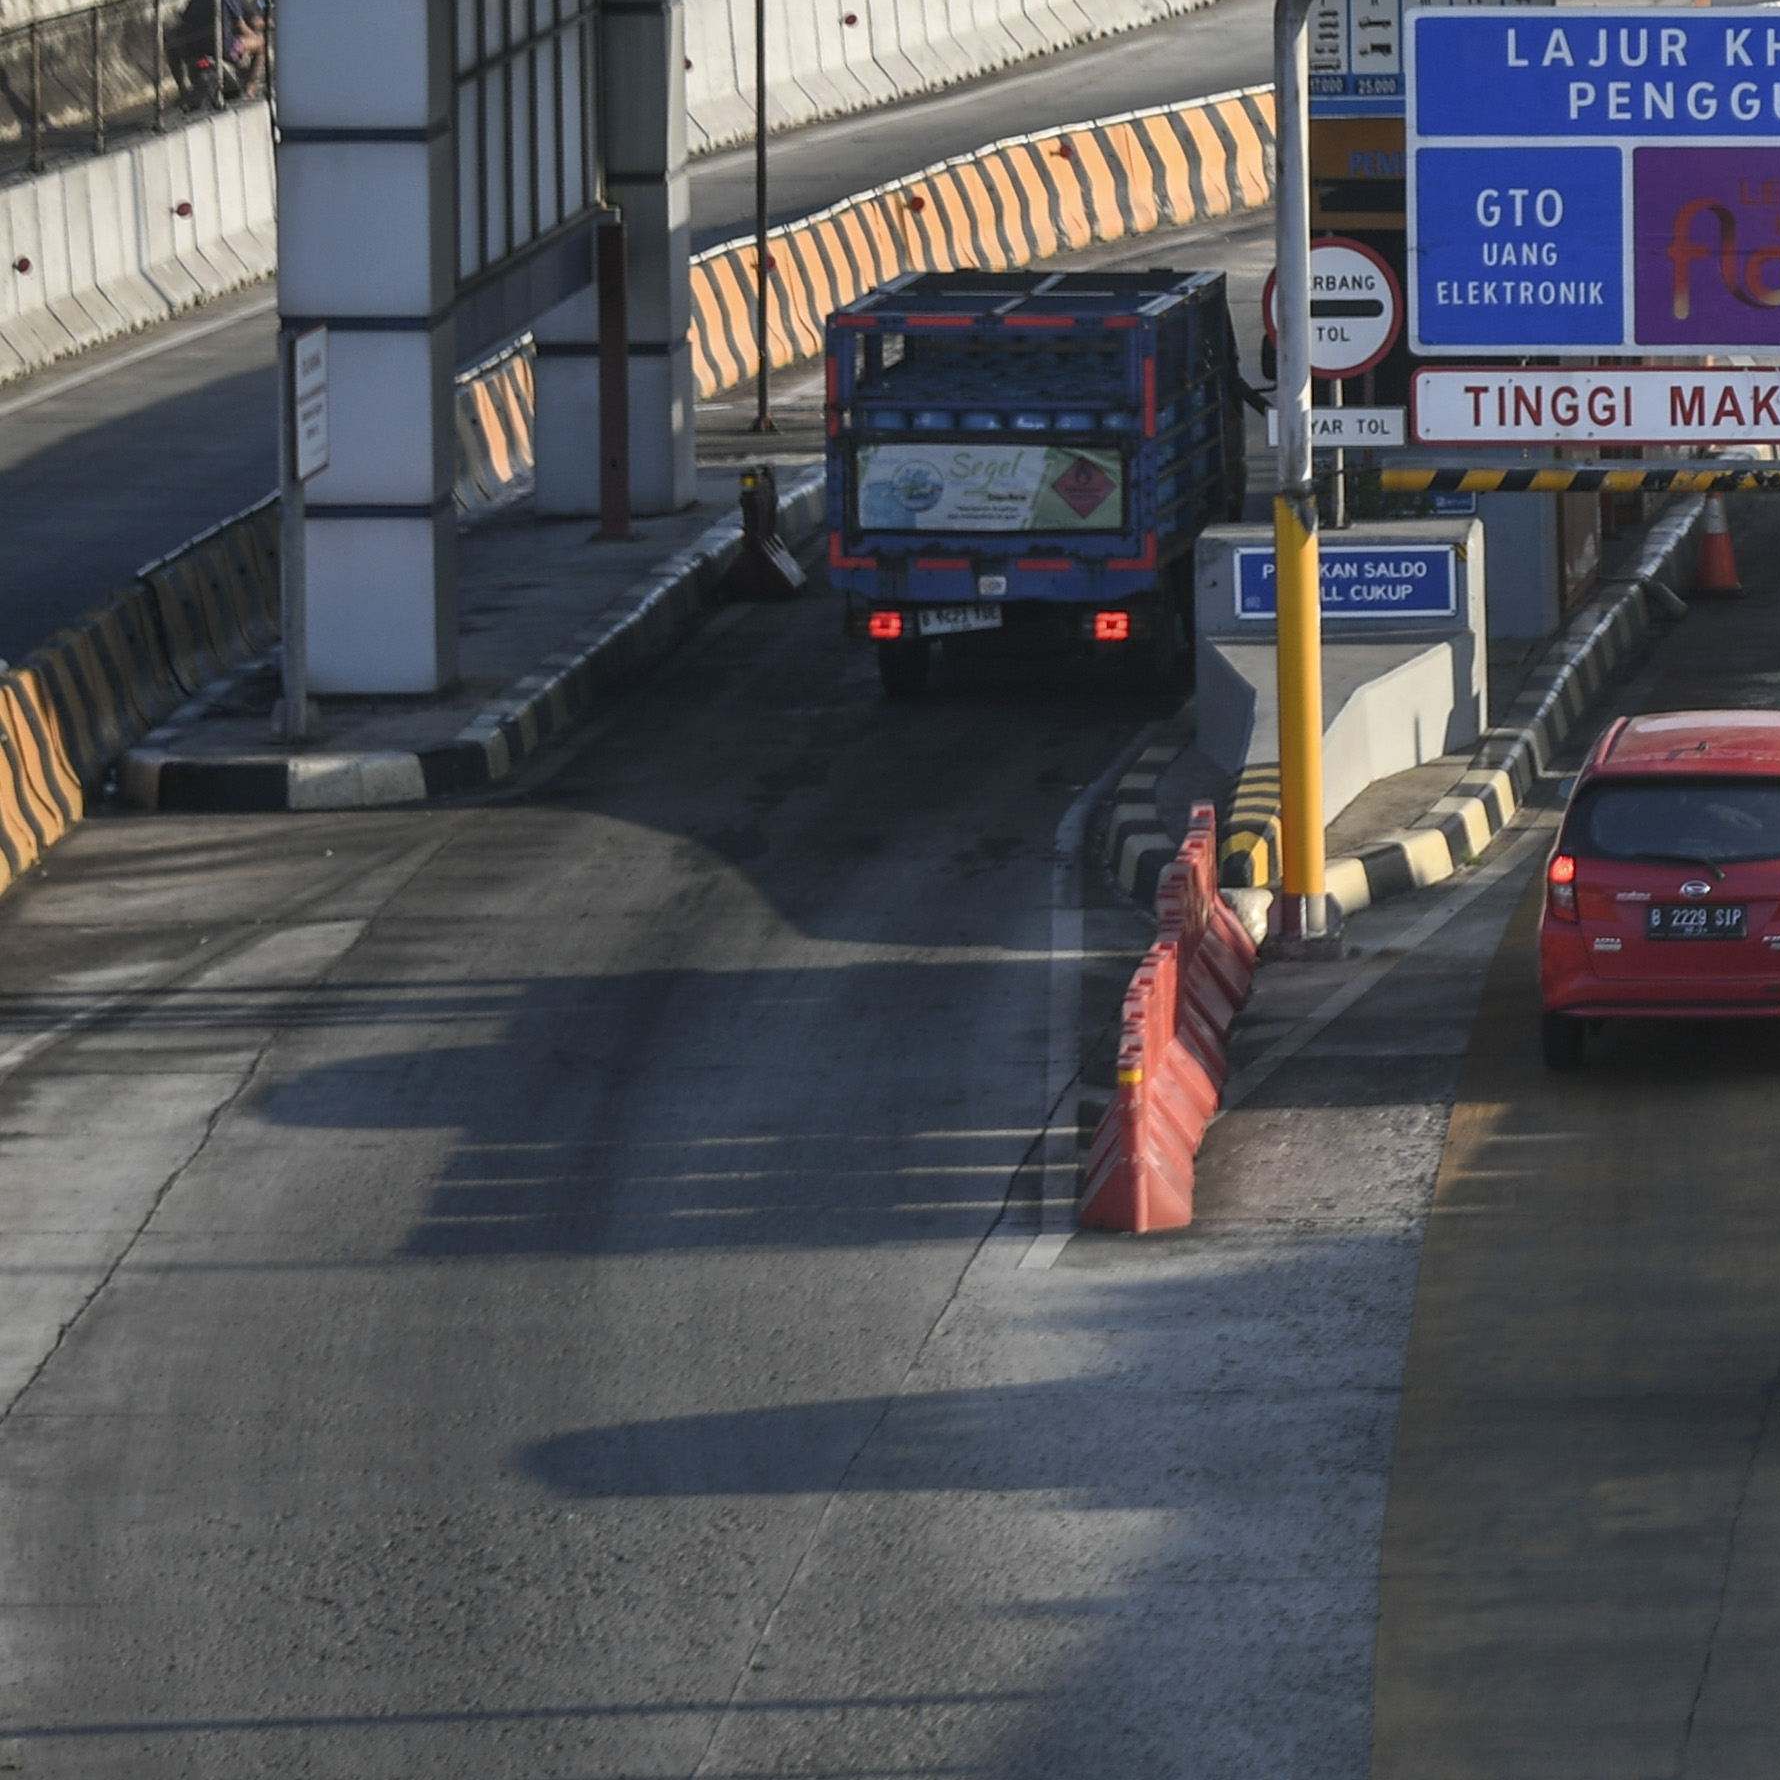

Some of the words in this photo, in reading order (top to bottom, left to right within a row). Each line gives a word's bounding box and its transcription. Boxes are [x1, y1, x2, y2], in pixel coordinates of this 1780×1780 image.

[1507, 27, 1688, 67] LAJUR
[1476, 188, 1563, 228] GTO
[1483, 242, 1558, 266] UANG
[1436, 281, 1604, 306] ELEKTRONIK
[1316, 326, 1350, 342] TOL
[1464, 386, 1633, 427] TINGGI
[1311, 419, 1343, 435] YAR
[1357, 418, 1390, 434] TOL
[1364, 561, 1427, 578] SALDO
[1350, 585, 1413, 601] CUKUP
[1651, 908, 1661, 926] B
[1671, 908, 1707, 927] 2229
[1715, 908, 1742, 926] SIP
